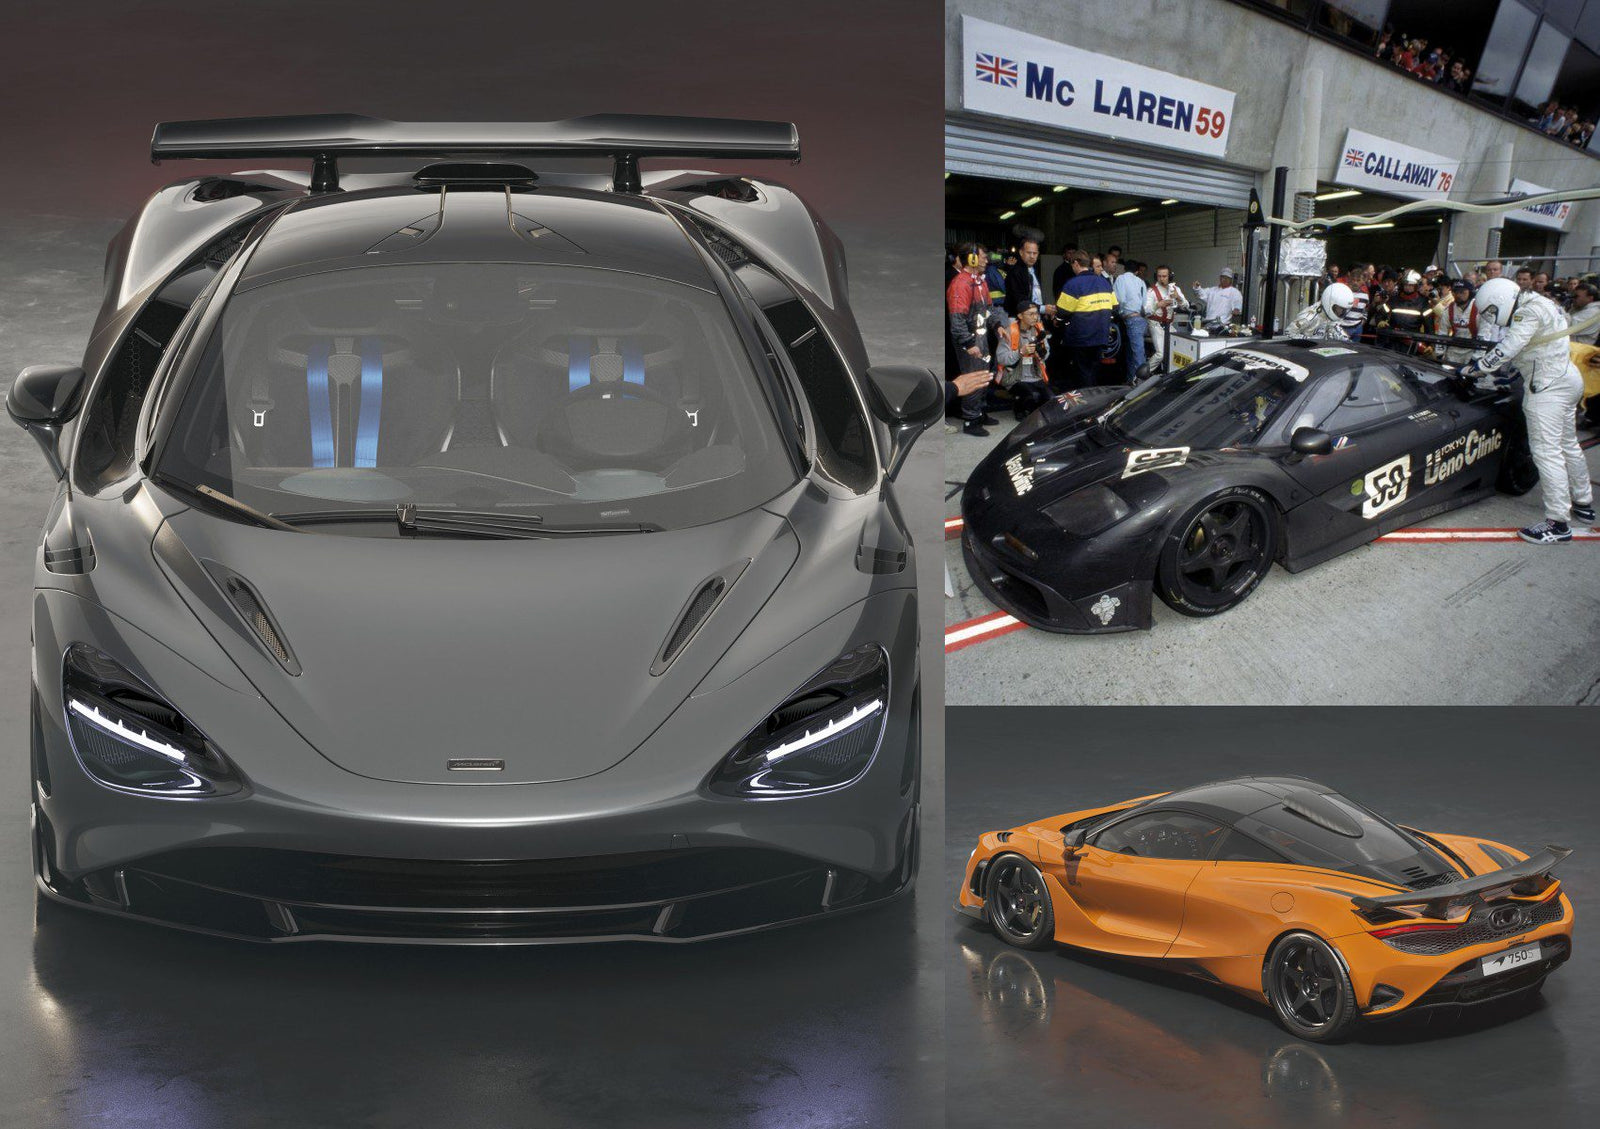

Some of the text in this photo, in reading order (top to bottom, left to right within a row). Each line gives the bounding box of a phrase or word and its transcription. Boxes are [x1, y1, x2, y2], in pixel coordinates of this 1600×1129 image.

[1025, 61, 1226, 139] Mc LAREN 59
[1364, 151, 1453, 193] CALLAWAY 76
[1424, 428, 1503, 486] Ueno Clinic
[1441, 436, 1467, 457] TOKYO
[1370, 466, 1406, 509] 59
